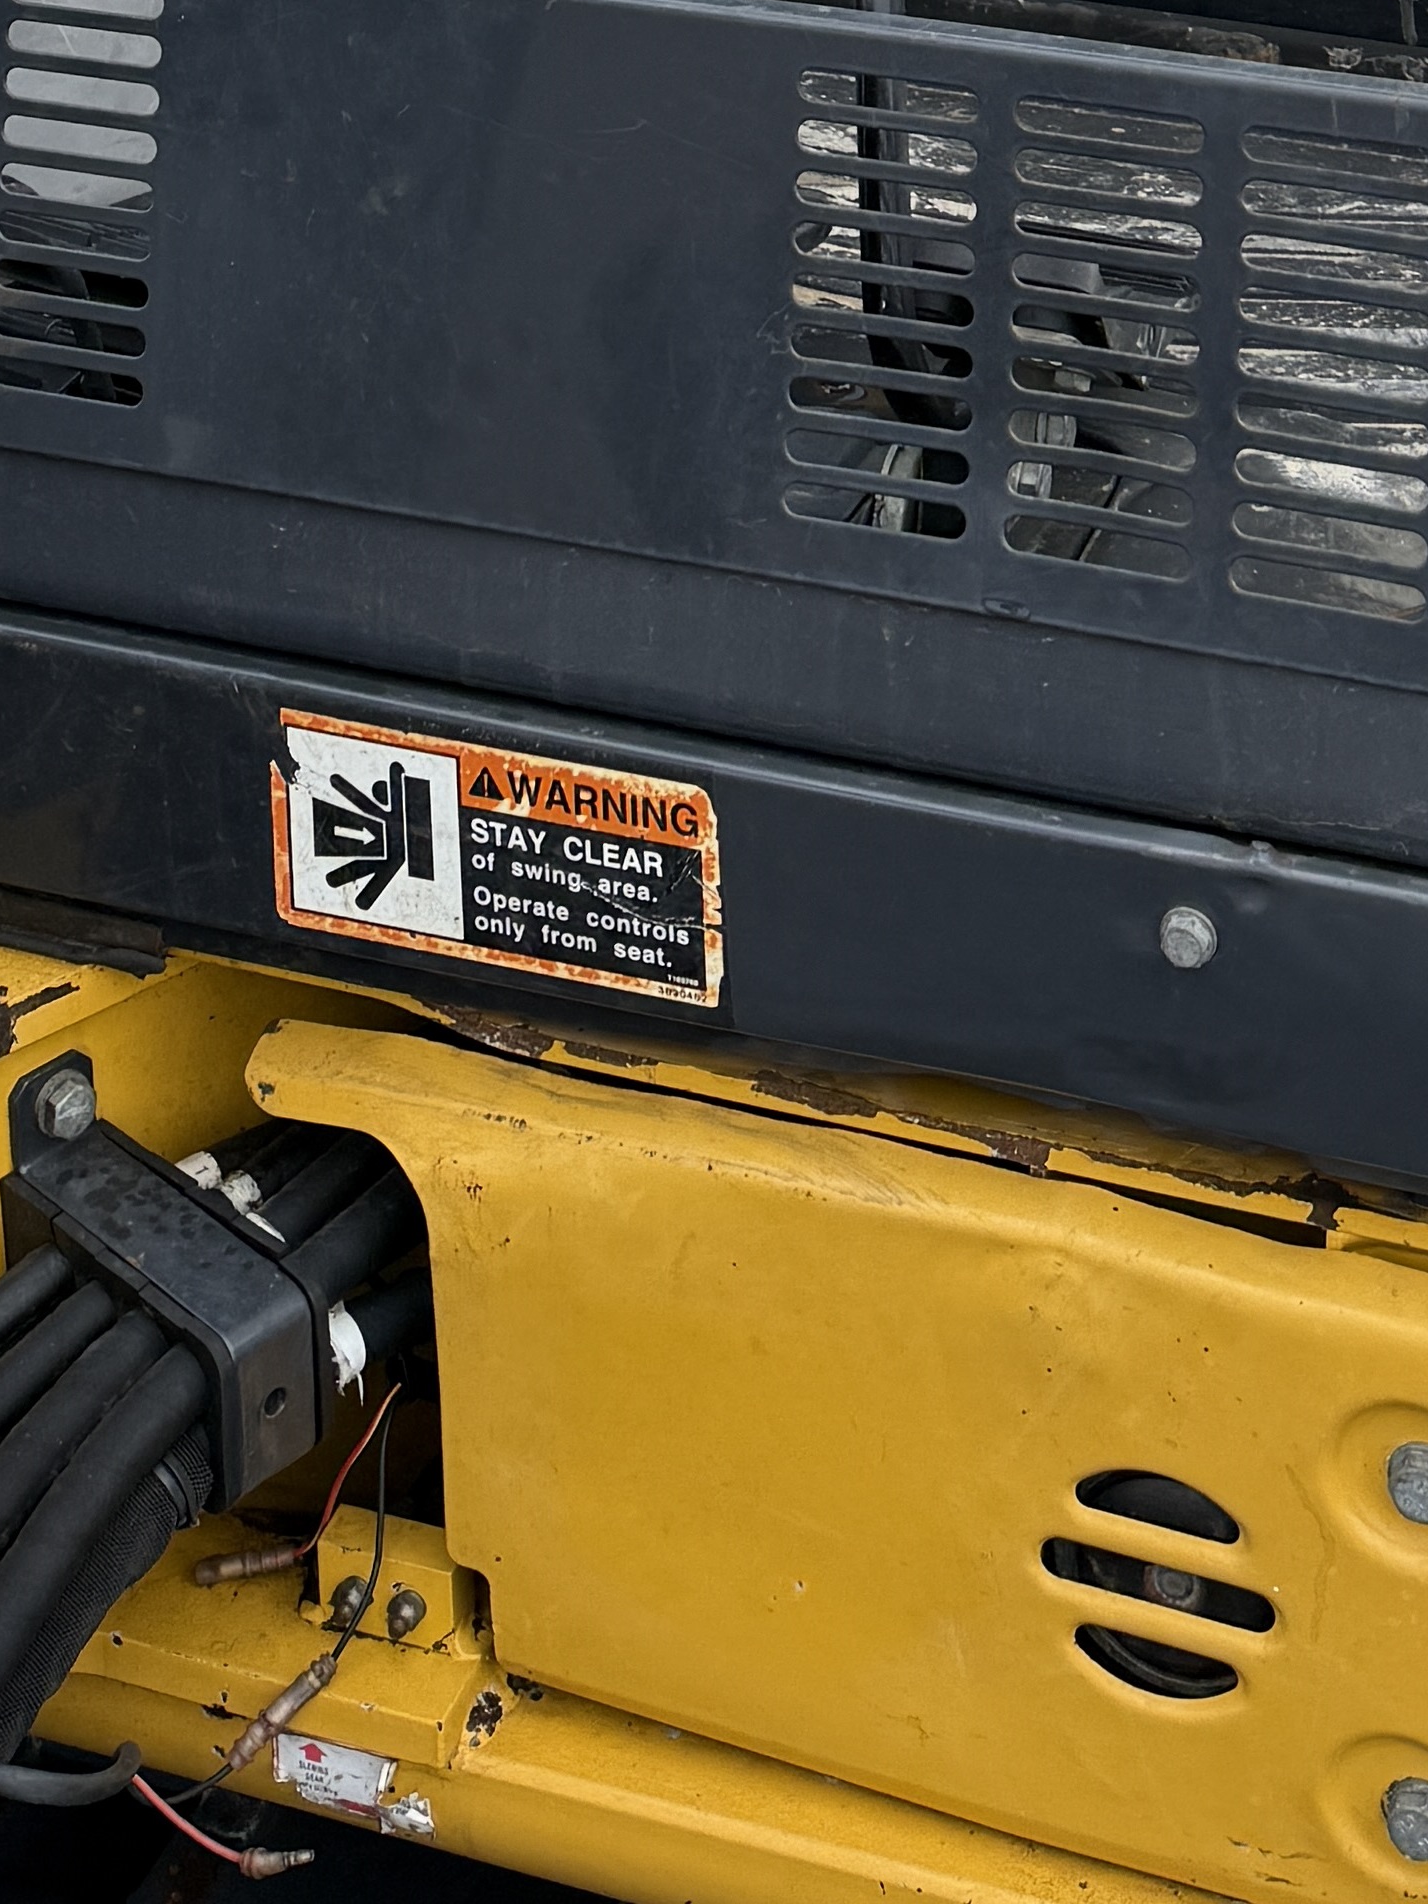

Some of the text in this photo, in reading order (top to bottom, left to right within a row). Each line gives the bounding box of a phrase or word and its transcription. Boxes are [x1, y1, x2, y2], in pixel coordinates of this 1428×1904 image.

[506, 770, 700, 839] WARNING
[470, 817, 663, 878] STAY CLEAR
[471, 852, 658, 903] of swing area.
[473, 886, 690, 946] Operate controls
[475, 913, 672, 968] only from seat.
